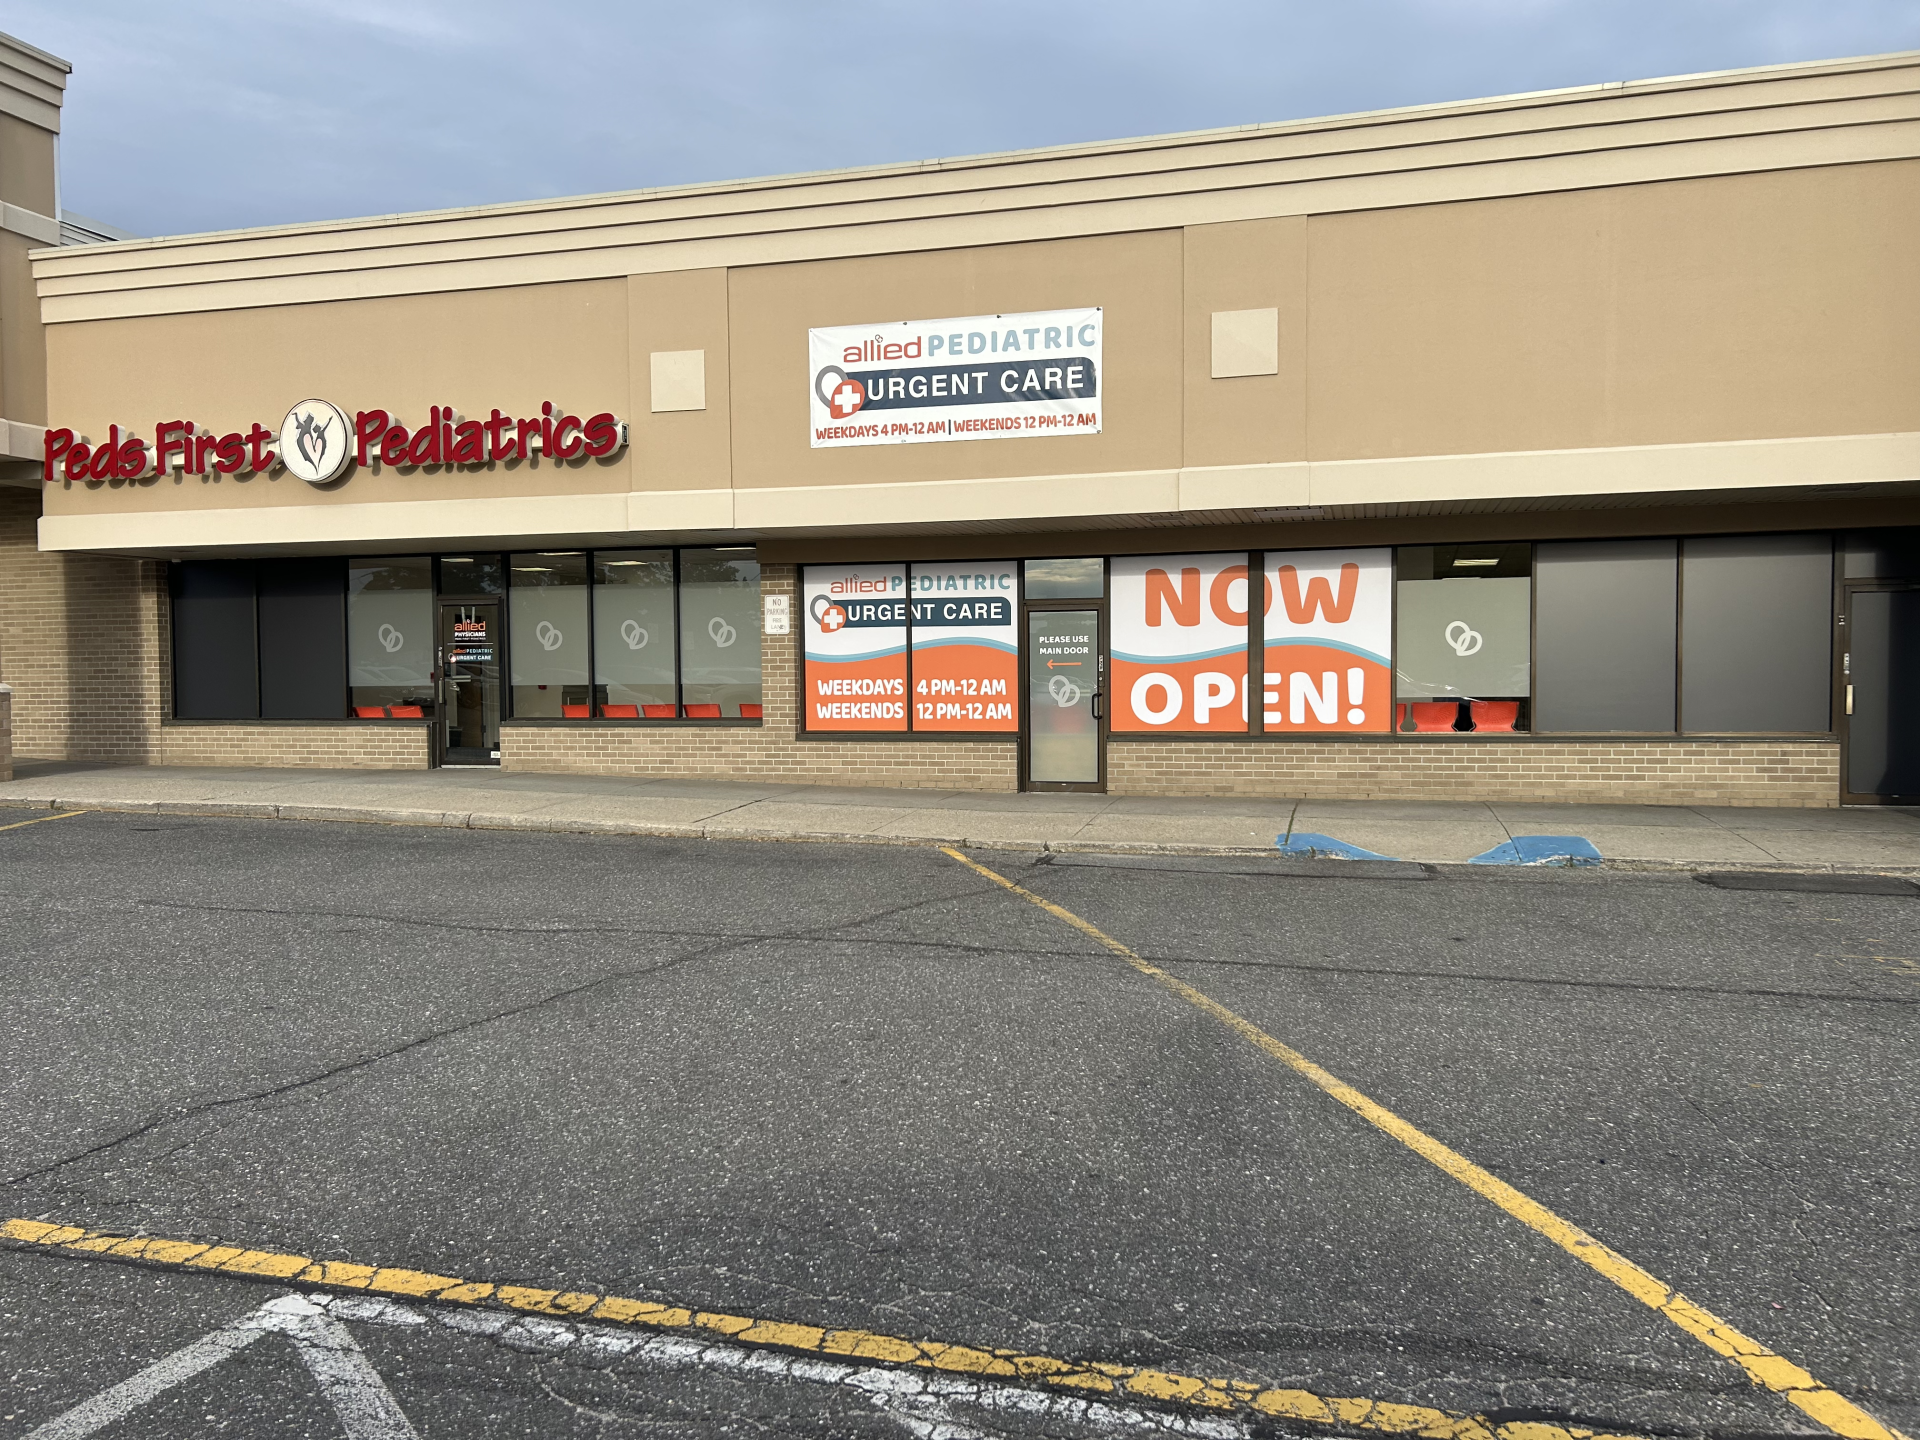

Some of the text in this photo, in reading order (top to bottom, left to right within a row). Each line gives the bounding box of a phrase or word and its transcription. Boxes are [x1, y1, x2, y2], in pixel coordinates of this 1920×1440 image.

[843, 324, 1096, 363] allied PEDIATRIC
[867, 366, 1084, 401] URGENT CARE
[816, 421, 946, 440] WEEKDAYS 4 PM-12 AM
[954, 413, 1097, 432] WEEKENDS 12 PM-12 AM
[44, 400, 618, 482] Peds First Pediatrics
[830, 573, 1011, 594] allied PEDIATRIC
[1145, 562, 1359, 627] NOW
[848, 602, 1003, 621] URGENT CARE
[454, 619, 486, 631] allied
[1039, 635, 1070, 644] PLEASE
[817, 678, 1006, 696] WEEKDAYS 4 PM-12 AM
[1130, 667, 1366, 725] OPEN!
[816, 702, 1012, 720] WEEKENDS 12 PM-12 AM
